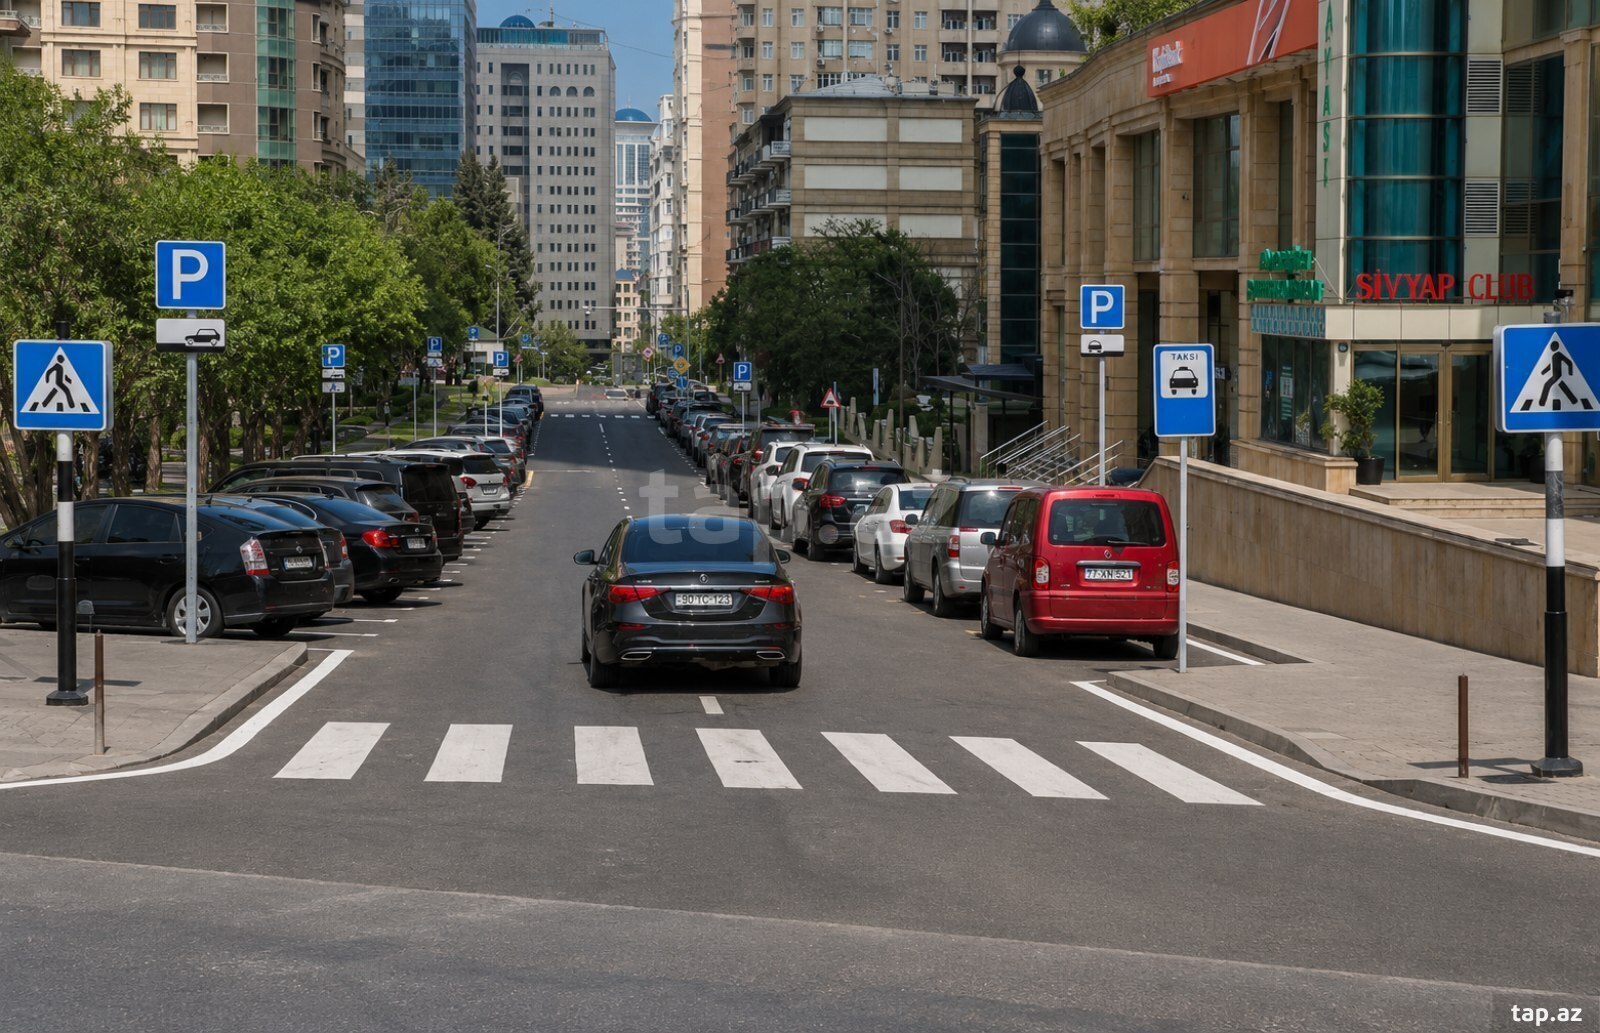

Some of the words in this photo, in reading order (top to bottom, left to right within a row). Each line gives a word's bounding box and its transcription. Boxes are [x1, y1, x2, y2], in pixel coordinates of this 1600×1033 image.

[172, 249, 209, 300] P
[1468, 273, 1534, 300] CLUB
[1091, 290, 1115, 324] P
[430, 338, 439, 351] P
[327, 347, 341, 365] P
[496, 353, 505, 367] P
[738, 364, 748, 379] P
